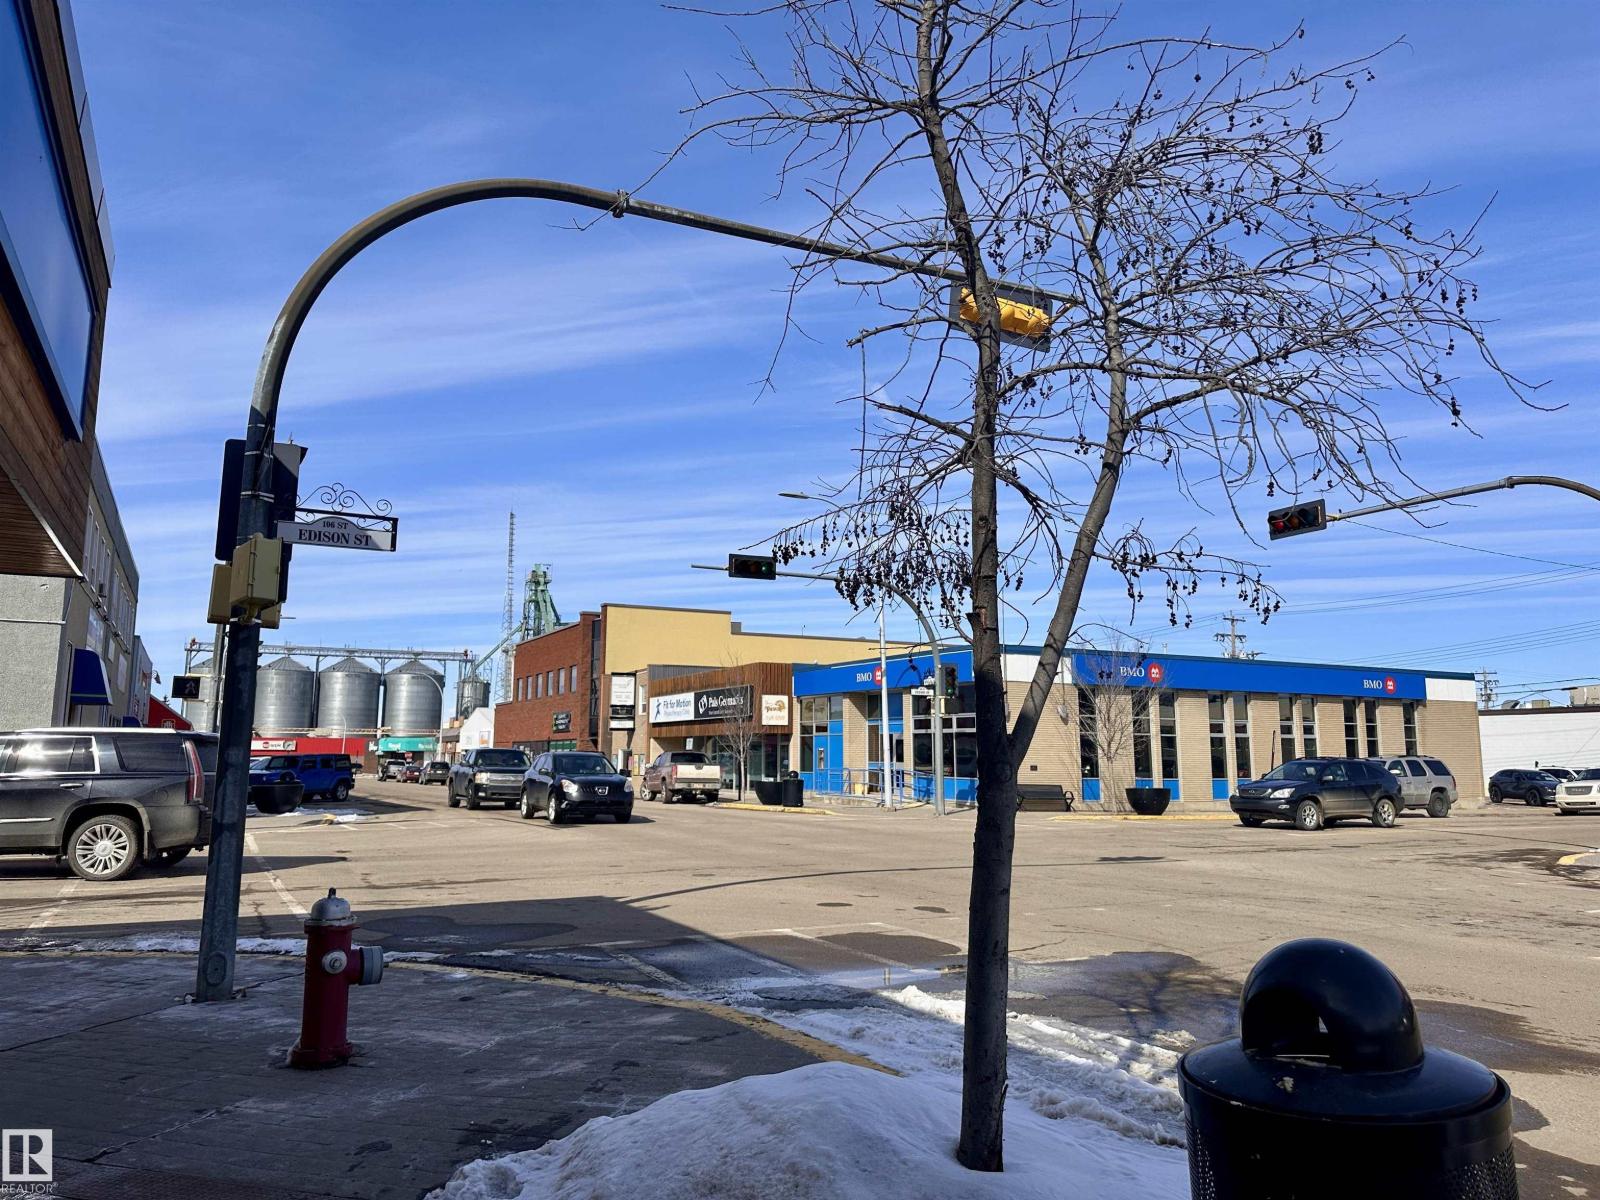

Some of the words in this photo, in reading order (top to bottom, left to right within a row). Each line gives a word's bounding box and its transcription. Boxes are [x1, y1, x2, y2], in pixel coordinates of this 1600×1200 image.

[337, 522, 349, 530] ST
[299, 528, 350, 545] EDISON
[353, 534, 372, 547] ST
[1120, 666, 1145, 678] BMO
[856, 672, 873, 683] BMO
[1363, 679, 1383, 689] BMO
[675, 698, 692, 708] Motion
